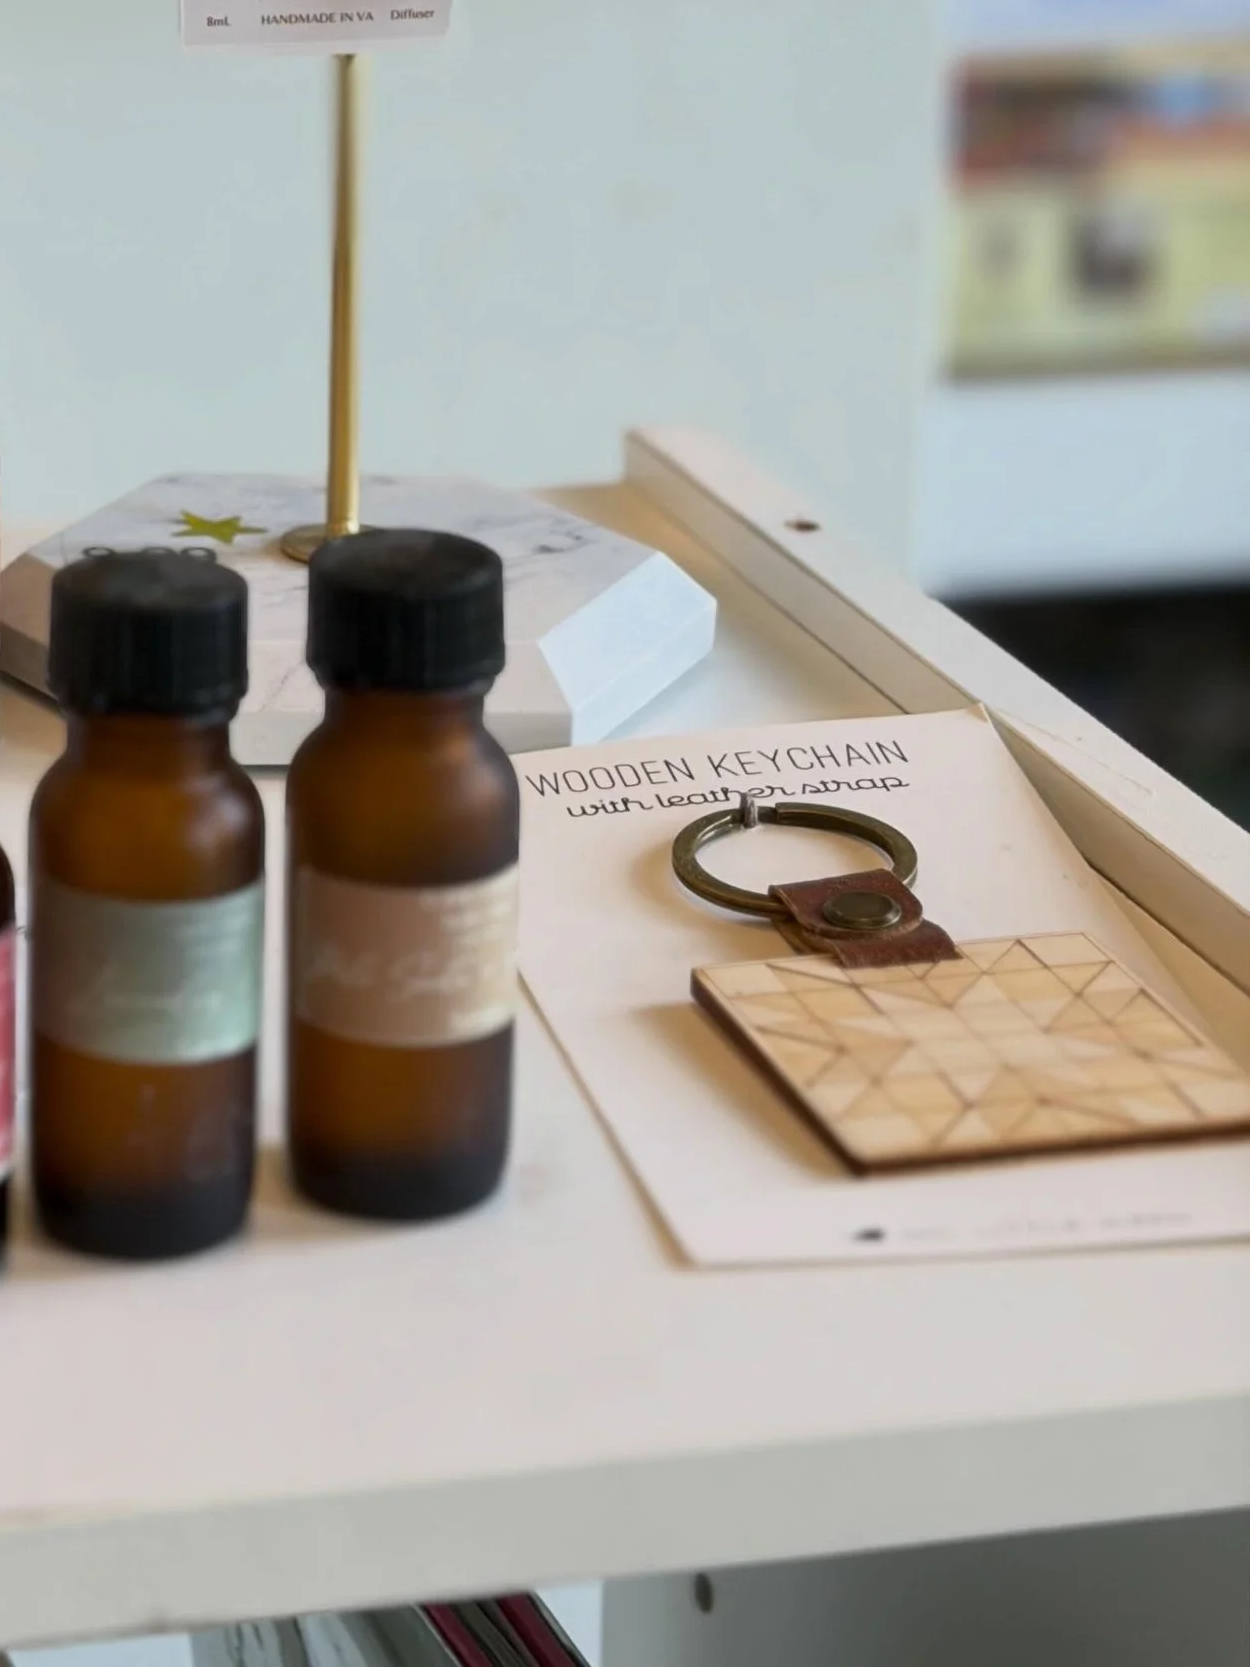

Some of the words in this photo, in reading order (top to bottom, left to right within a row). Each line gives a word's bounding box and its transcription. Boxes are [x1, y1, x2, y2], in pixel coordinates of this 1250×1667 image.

[261, 13, 336, 25] HANDMADE
[340, 12, 354, 23] IN
[356, 11, 374, 22] VA
[390, 9, 434, 21] Diffuser
[525, 756, 696, 798] WOODEN
[706, 739, 910, 779] KEYCHAIN
[566, 798, 651, 818] with
[654, 786, 795, 810] leather
[802, 775, 910, 798] strap
